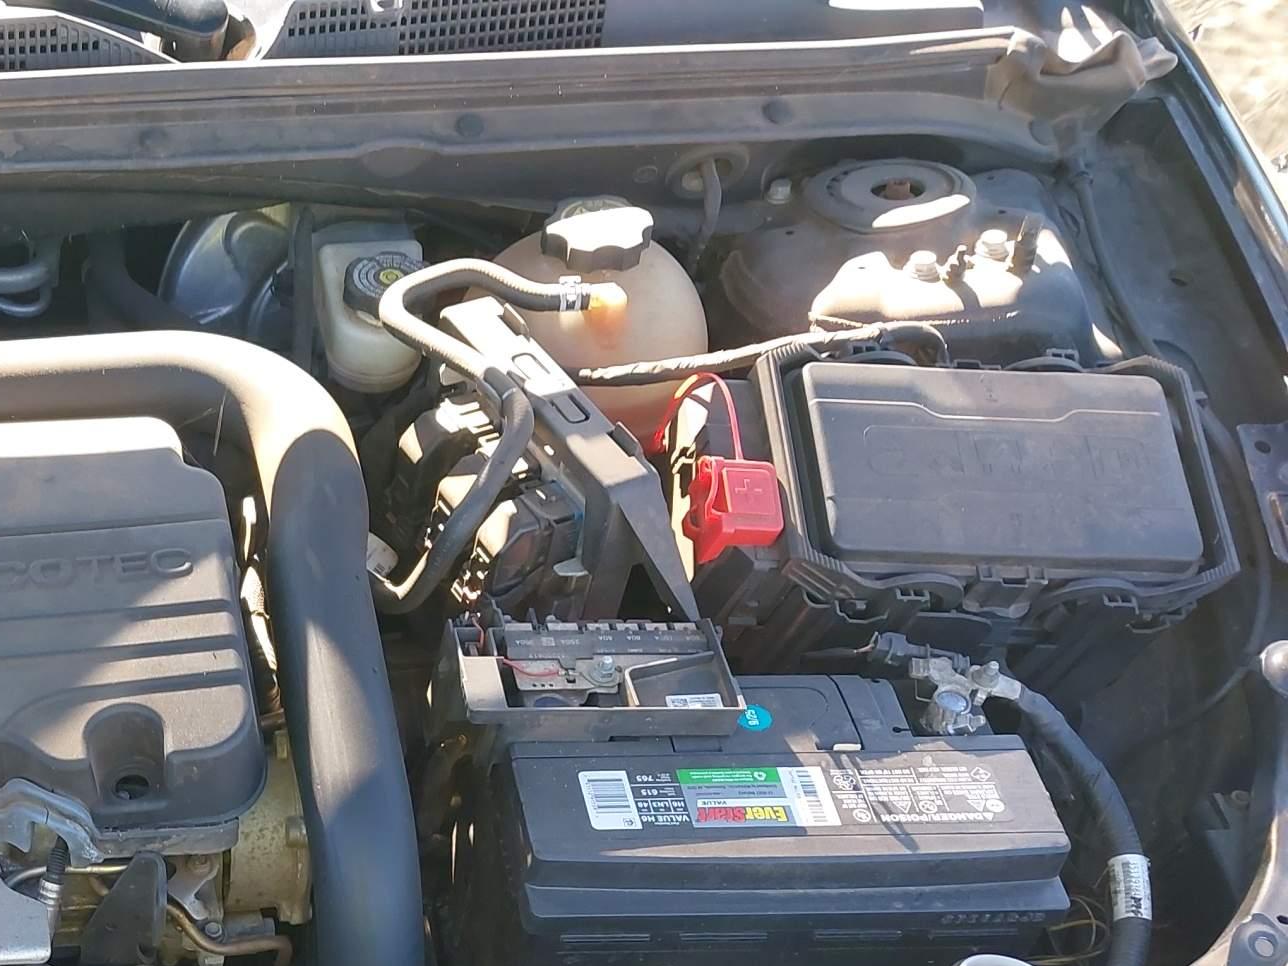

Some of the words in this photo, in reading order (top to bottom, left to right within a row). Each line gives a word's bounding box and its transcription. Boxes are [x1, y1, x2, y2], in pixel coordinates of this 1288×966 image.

[636, 774, 654, 782] 765
[640, 814, 655, 822] H6
[656, 814, 690, 822] VALUE
[696, 806, 788, 823] EverStart
